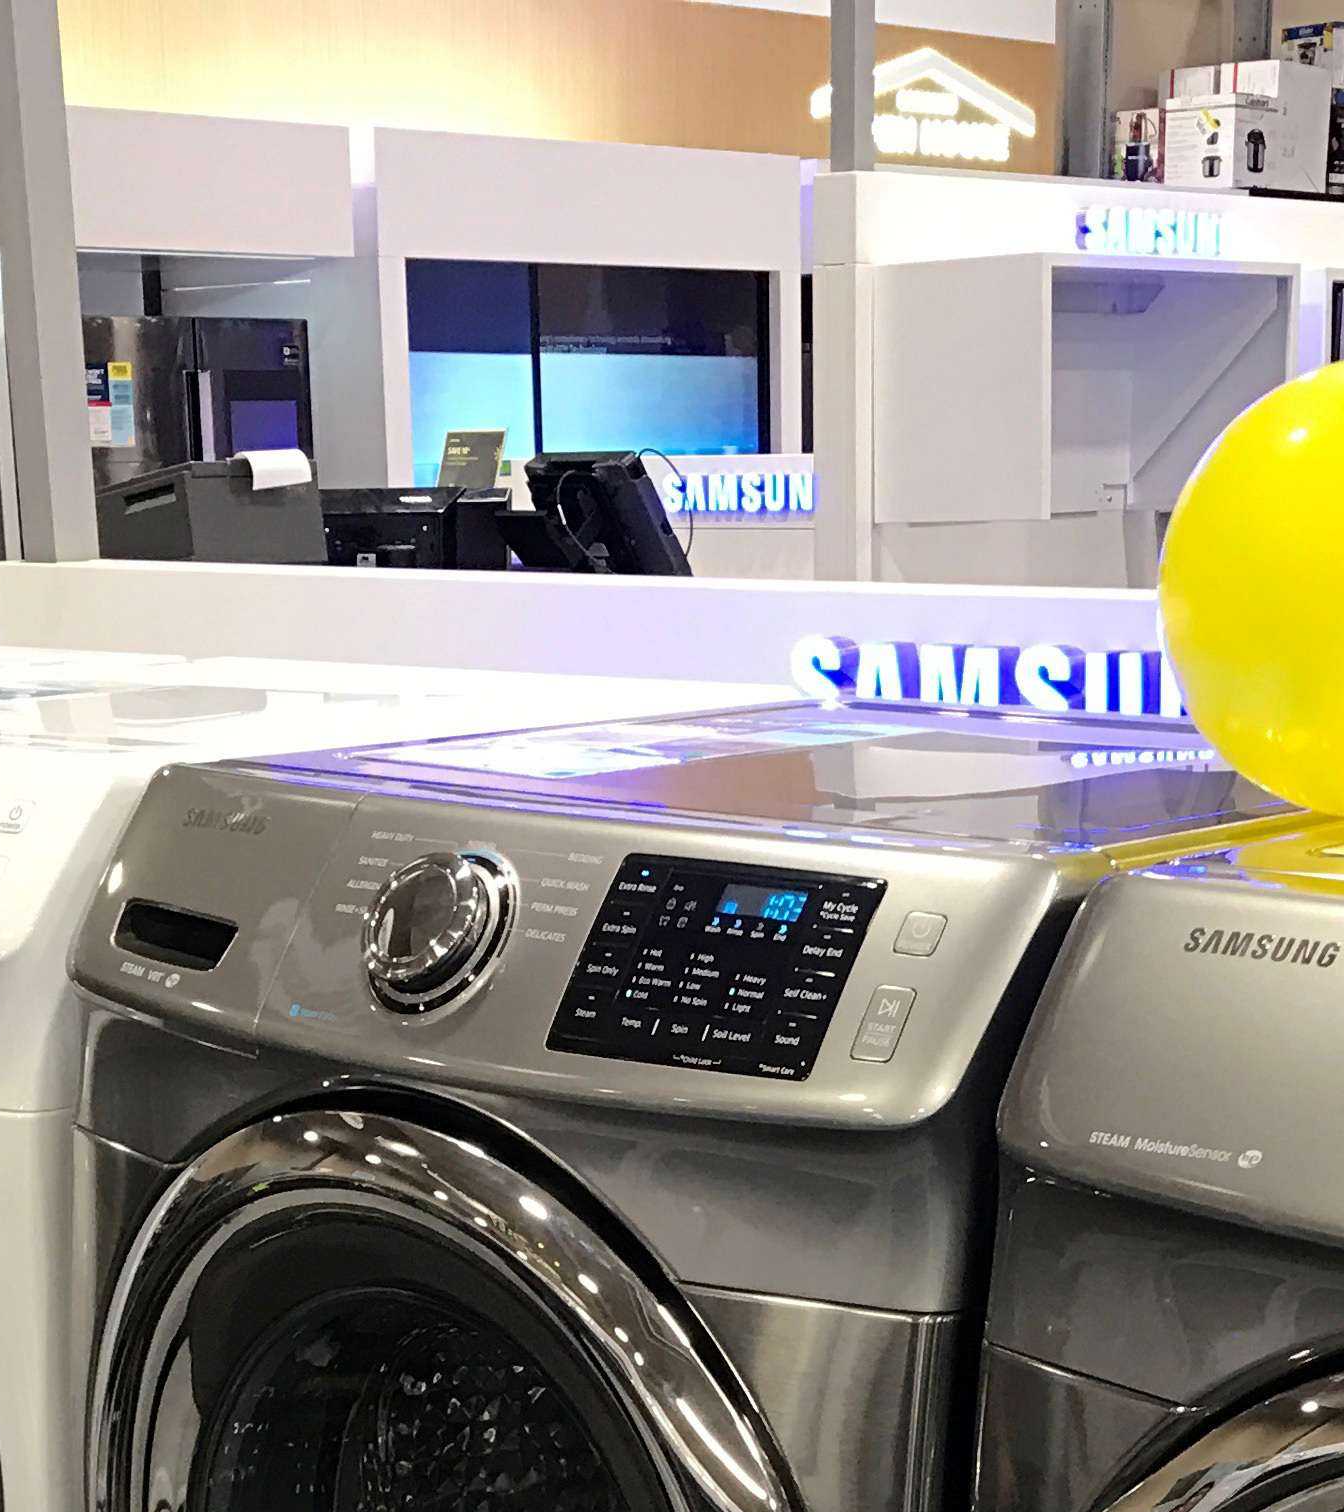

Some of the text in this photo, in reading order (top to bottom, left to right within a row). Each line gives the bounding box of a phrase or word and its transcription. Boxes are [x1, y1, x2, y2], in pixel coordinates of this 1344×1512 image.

[1084, 204, 1241, 256] SAMSUN
[662, 472, 814, 513] SAMSUN
[791, 635, 1186, 718] SAMSU
[618, 881, 656, 893] Extra Rinse
[823, 901, 858, 914] My Cycle
[601, 922, 636, 935] Extra Spin
[802, 945, 844, 958] Delay End
[1183, 927, 1342, 968] SAMSUNG
[697, 954, 715, 964] High
[119, 961, 147, 977] STEAM
[586, 963, 619, 976] Spin Only
[691, 968, 719, 978] Medium
[743, 975, 766, 986] Heavy
[686, 982, 701, 991] Low
[633, 990, 649, 999] Cold
[737, 989, 764, 1000] Normal
[784, 987, 800, 998] Self
[691, 997, 707, 1006] Spin
[575, 1008, 596, 1018] Steam
[732, 1003, 751, 1013] Light
[670, 1023, 688, 1034] Spin
[712, 1029, 751, 1042] Soil Level
[774, 1034, 800, 1045] Sound
[1088, 1131, 1233, 1162] STEAM MoistureSensor
